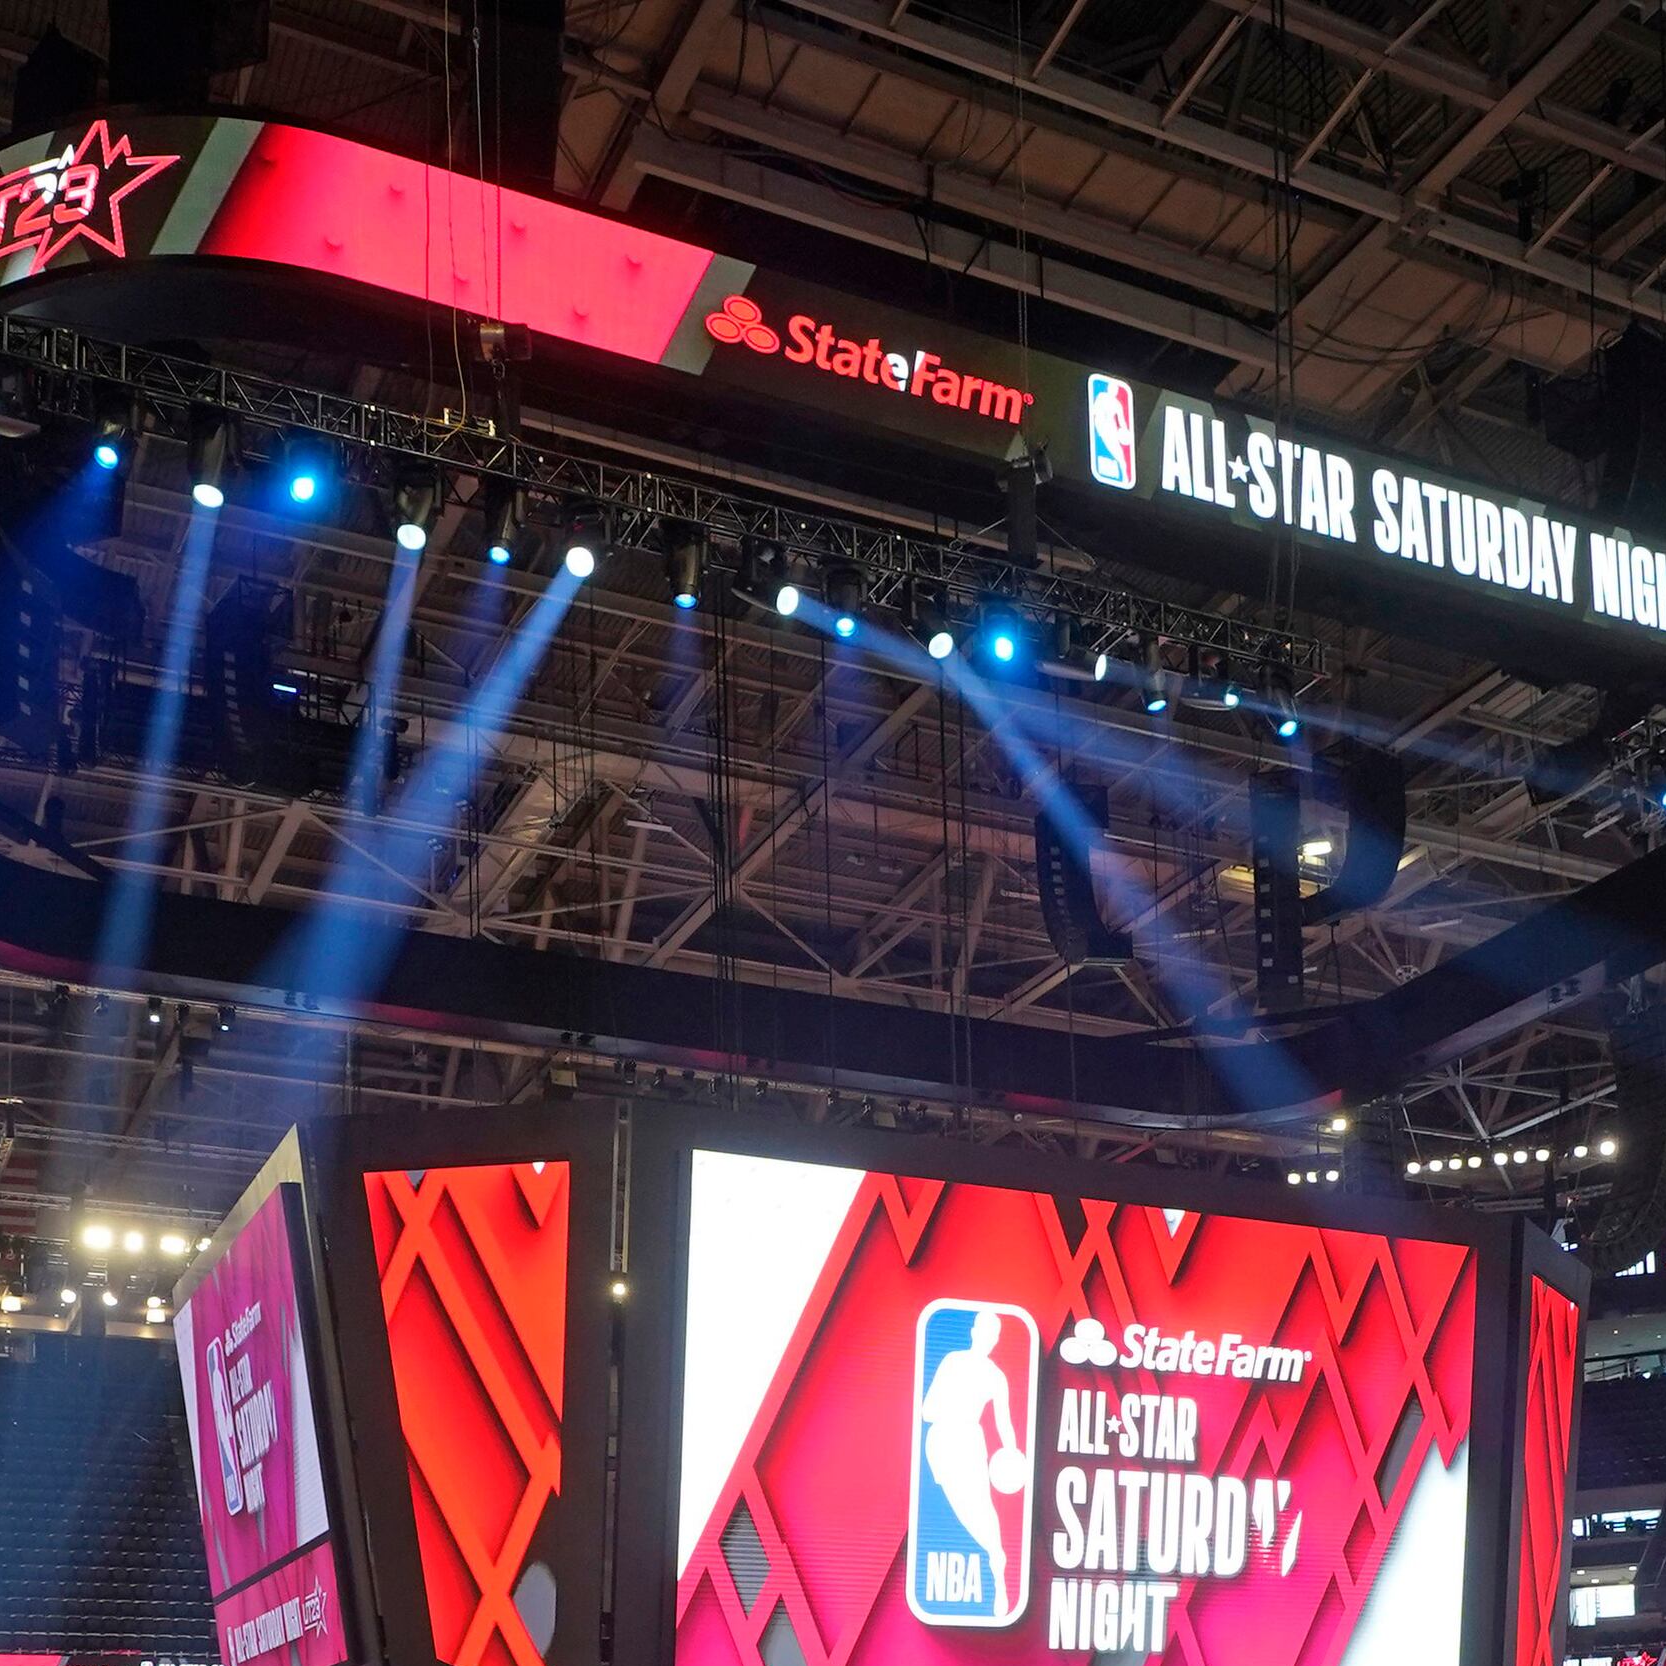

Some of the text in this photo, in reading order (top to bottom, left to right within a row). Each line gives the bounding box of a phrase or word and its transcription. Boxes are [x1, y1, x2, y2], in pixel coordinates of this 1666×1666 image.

[1371, 468, 1577, 604] SATURDAY
[925, 1551, 983, 1604] NBA
[1048, 1577, 1178, 1653] NIGHT
